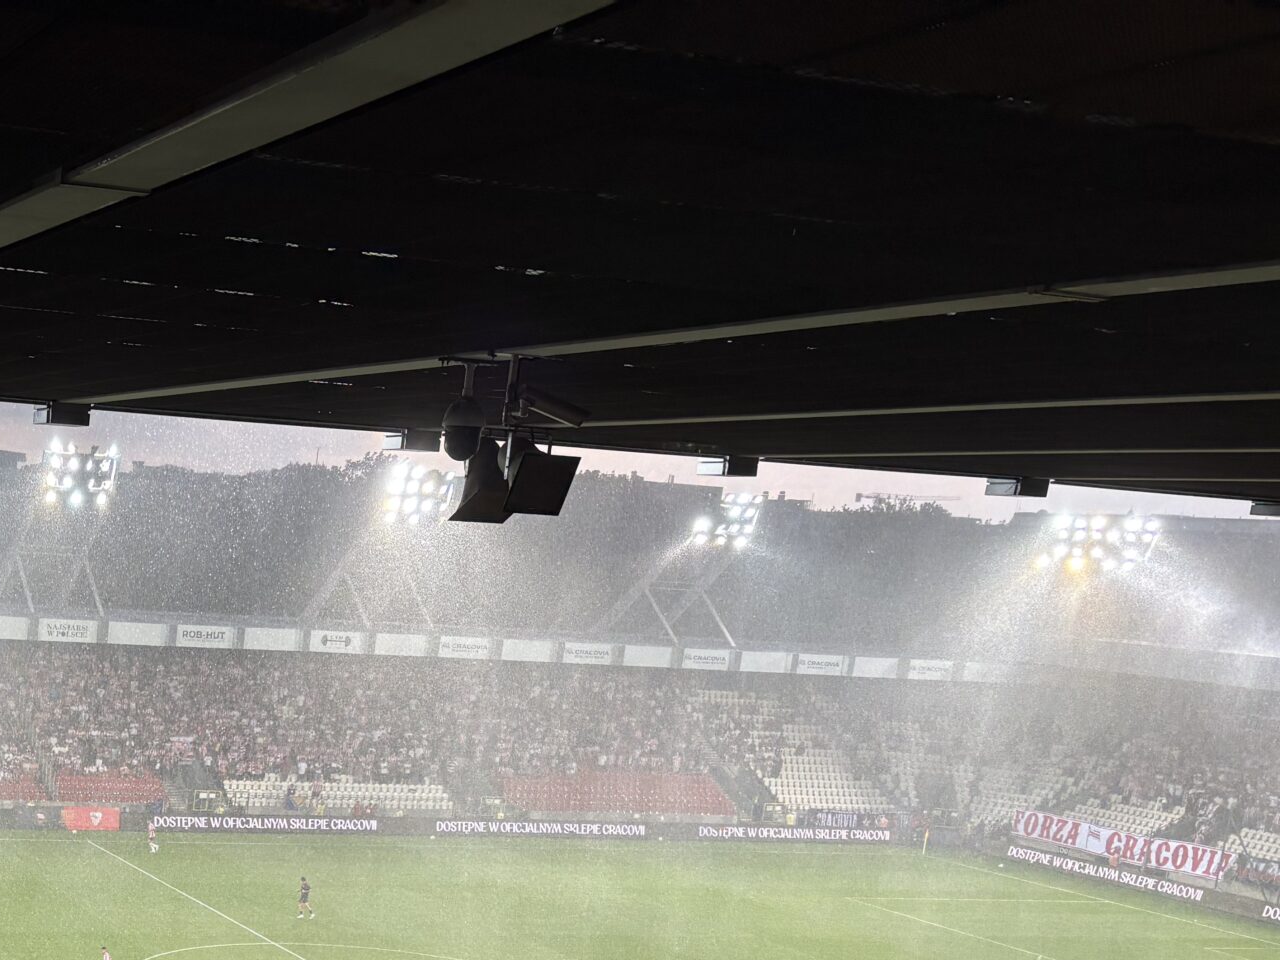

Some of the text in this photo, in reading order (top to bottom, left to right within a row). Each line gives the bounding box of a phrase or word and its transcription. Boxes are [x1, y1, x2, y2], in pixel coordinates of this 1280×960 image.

[182, 630, 226, 640] ROB-HUT
[807, 660, 840, 668] CRACOVIA
[154, 816, 376, 831] DOSTĘPNE W OFICJALNYM SKLEPIE CRACOVII
[436, 821, 645, 836] DOSTĘPNE W OFICJALNYM SKLEPIE CRACOVII
[699, 826, 890, 840] DOSTĘPNE W OFICJALNYM SKLEPIE CRACOVII
[1012, 810, 1081, 847] FORZA
[1105, 831, 1232, 877] CRACOVIA
[1008, 846, 1052, 864] DOSTĘPNE
[1052, 855, 1063, 868] W
[1062, 858, 1120, 882] OFICJALNYM
[1120, 872, 1158, 890] SKLEPIE
[1157, 880, 1204, 901] CRACOVII
[1262, 905, 1280, 920] DO
